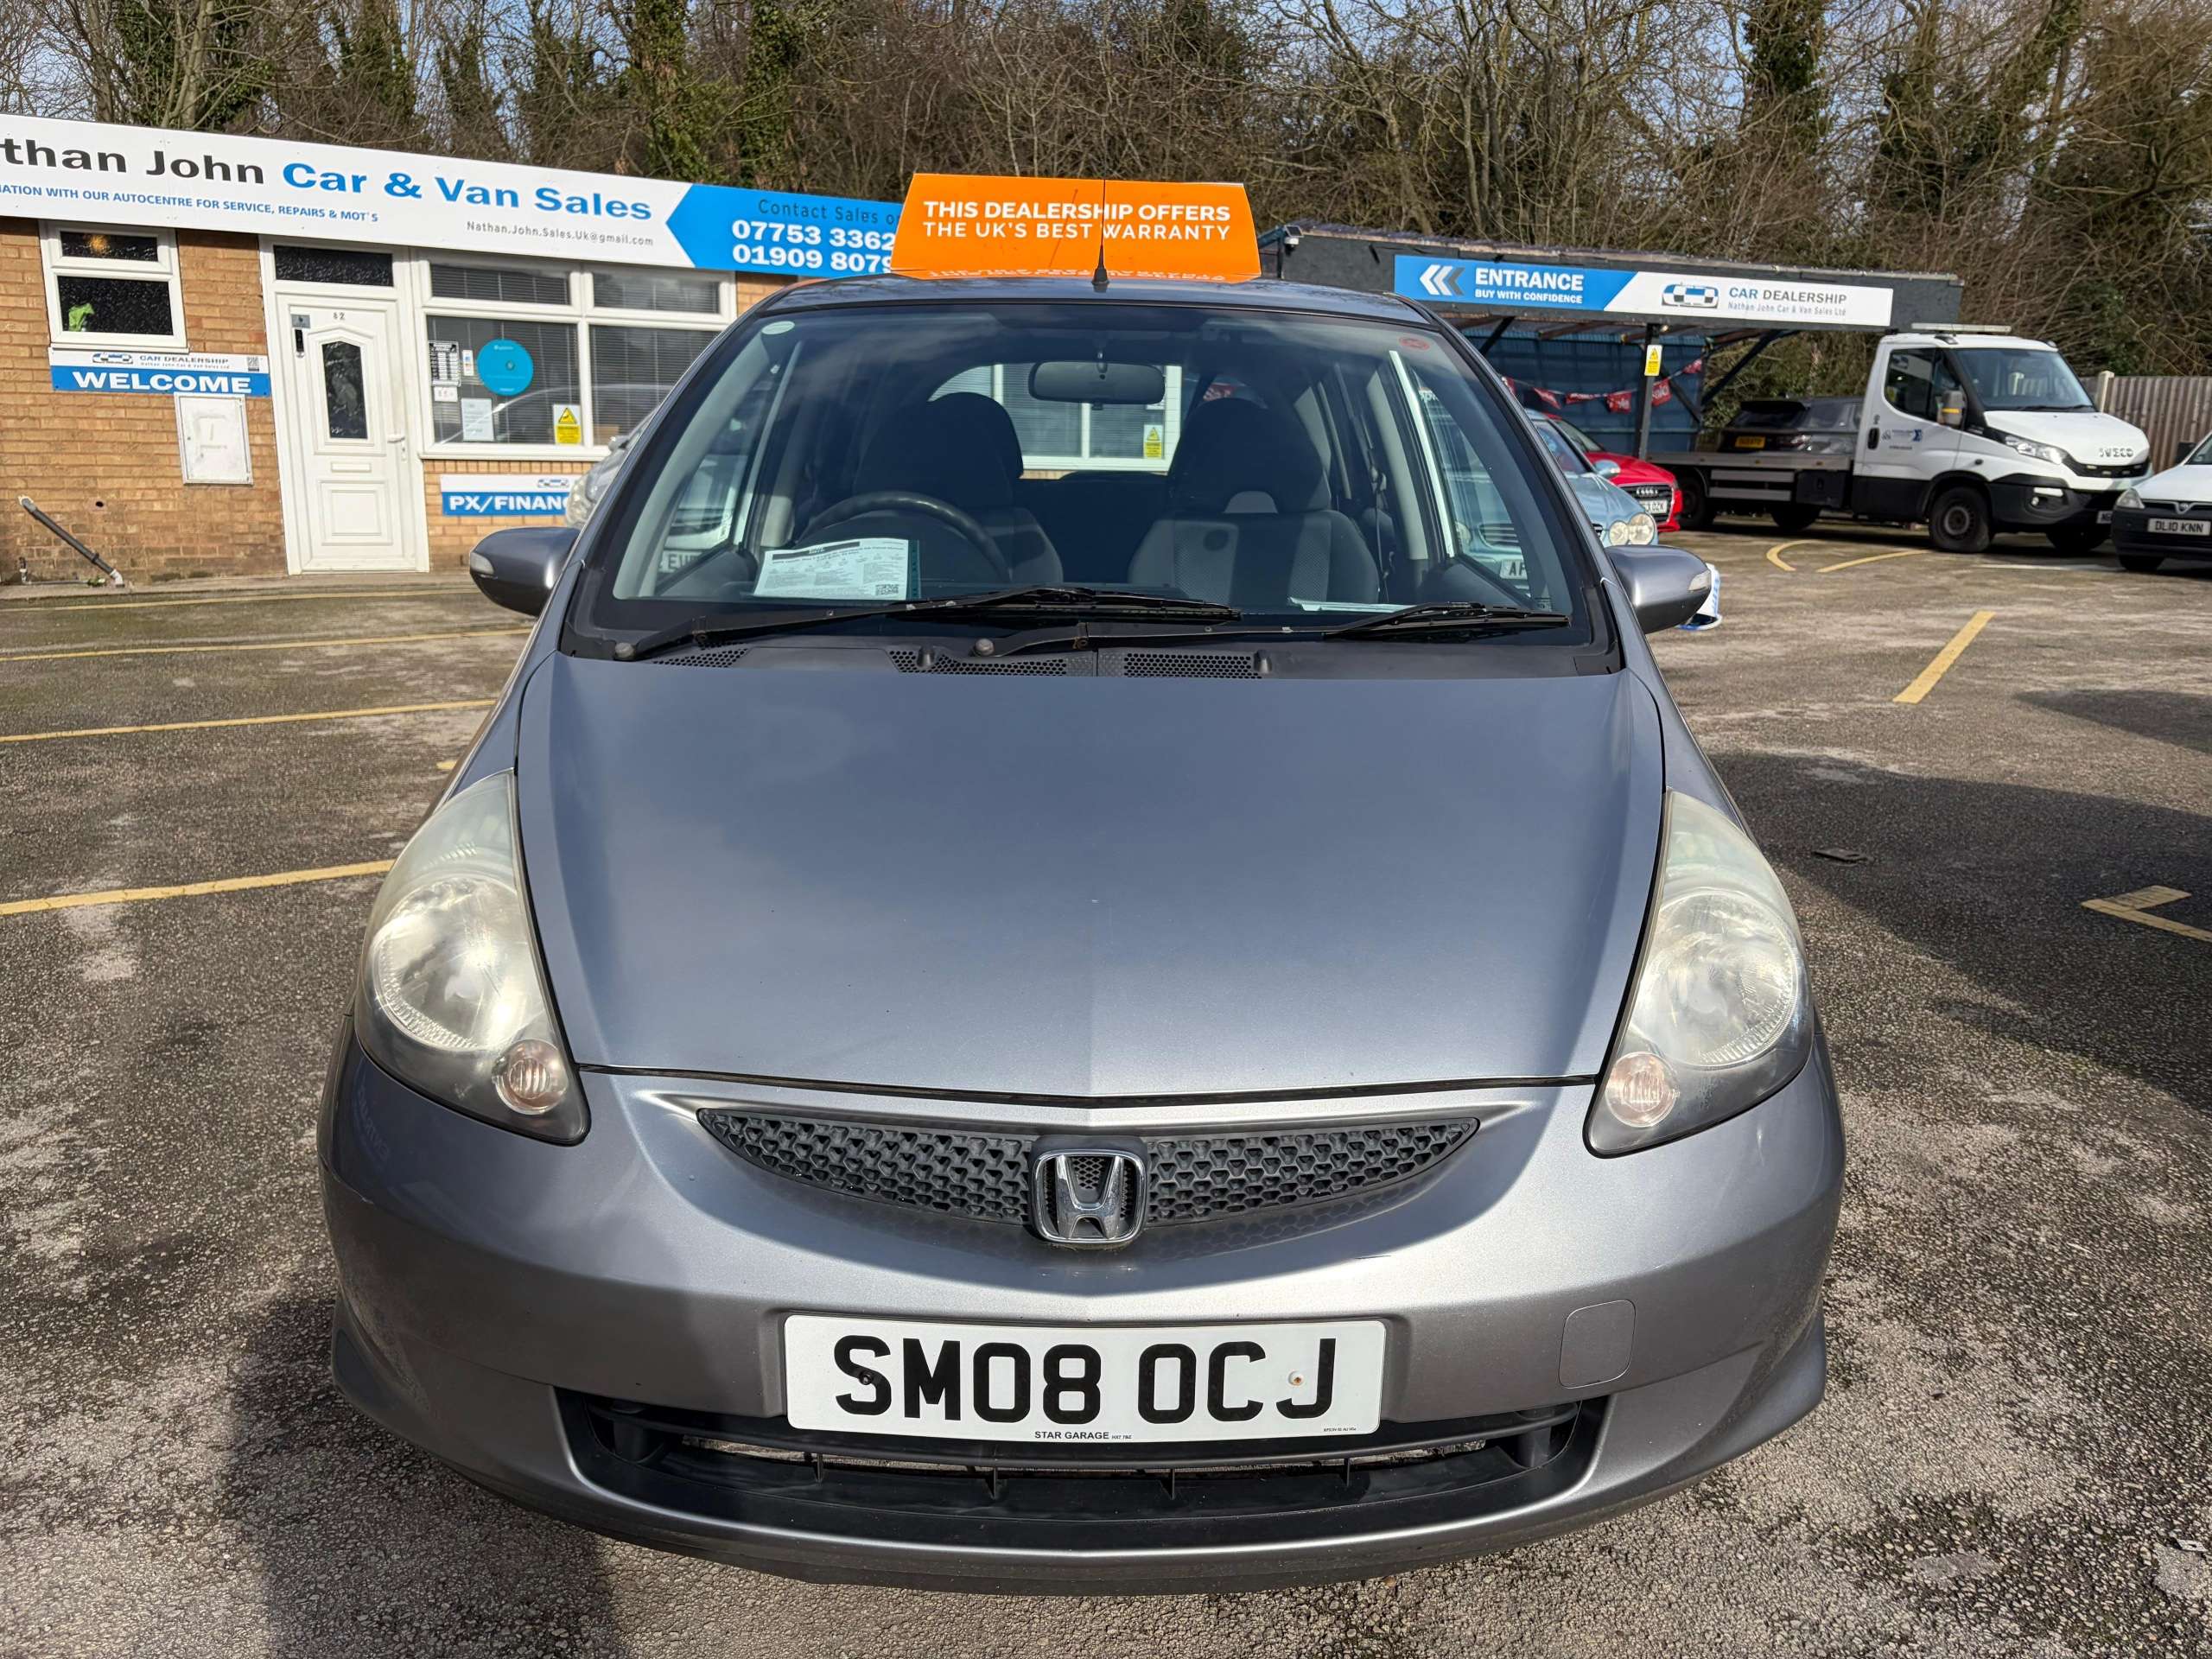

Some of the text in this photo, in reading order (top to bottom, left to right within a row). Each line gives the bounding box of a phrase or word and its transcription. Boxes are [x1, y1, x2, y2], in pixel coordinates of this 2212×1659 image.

[145, 150, 264, 185] John
[283, 162, 367, 194] Car
[384, 172, 423, 200] &
[435, 177, 519, 208] Van
[534, 187, 652, 220] Sales
[46, 187, 79, 199] WITH
[82, 190, 110, 201] OUR
[113, 193, 192, 207] AUTOCENTRE
[196, 199, 219, 209] FOR
[223, 200, 275, 214] SERVICE,
[278, 206, 325, 218] REPAIRS
[328, 209, 337, 219] &
[758, 199, 827, 219] Contact
[836, 206, 878, 225] Sales
[923, 200, 1231, 222] THIS DEALERSHIP OFFERS
[732, 219, 897, 251] 07753 3362
[923, 221, 1230, 240] THE UK'S BEST WARRANTY
[732, 245, 823, 270] 01909
[1475, 267, 1584, 291] ENTRANCE
[1475, 289, 1583, 304] BUY WITH CONFIDENCE
[1729, 287, 1847, 305] CAR DEALERSHIP
[73, 372, 251, 393] WELCOME
[834, 1334, 1337, 1426] SM08 OCJ
[1065, 1431, 1109, 1440] GARAGE
